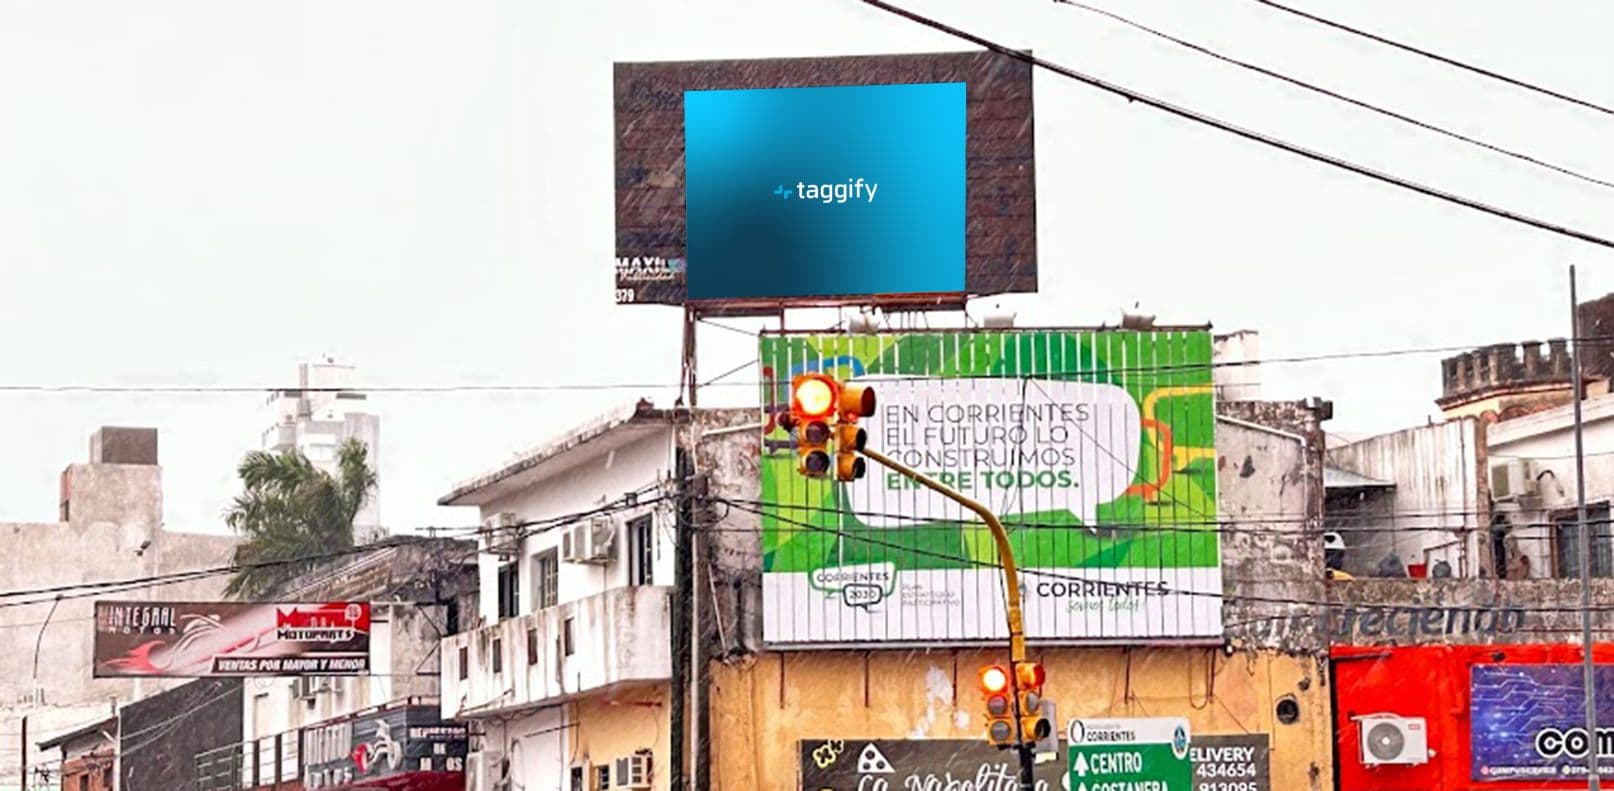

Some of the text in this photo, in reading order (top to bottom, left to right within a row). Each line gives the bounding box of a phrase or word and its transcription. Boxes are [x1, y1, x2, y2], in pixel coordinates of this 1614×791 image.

[797, 178, 878, 203] taggify
[886, 403, 1090, 424] EN CORRIENTES
[886, 425, 1069, 446] EL FUTURO LO
[980, 470, 1080, 489] TODOS.
[849, 590, 877, 599] 2030
[1036, 581, 1169, 598] CORRIENTES
[218, 658, 366, 671] VENTAS POR MAYOR Y MENOR
[1090, 752, 1142, 774] CENTRO
[1189, 747, 1255, 762] ELIVERY
[1196, 763, 1257, 777] 434654
